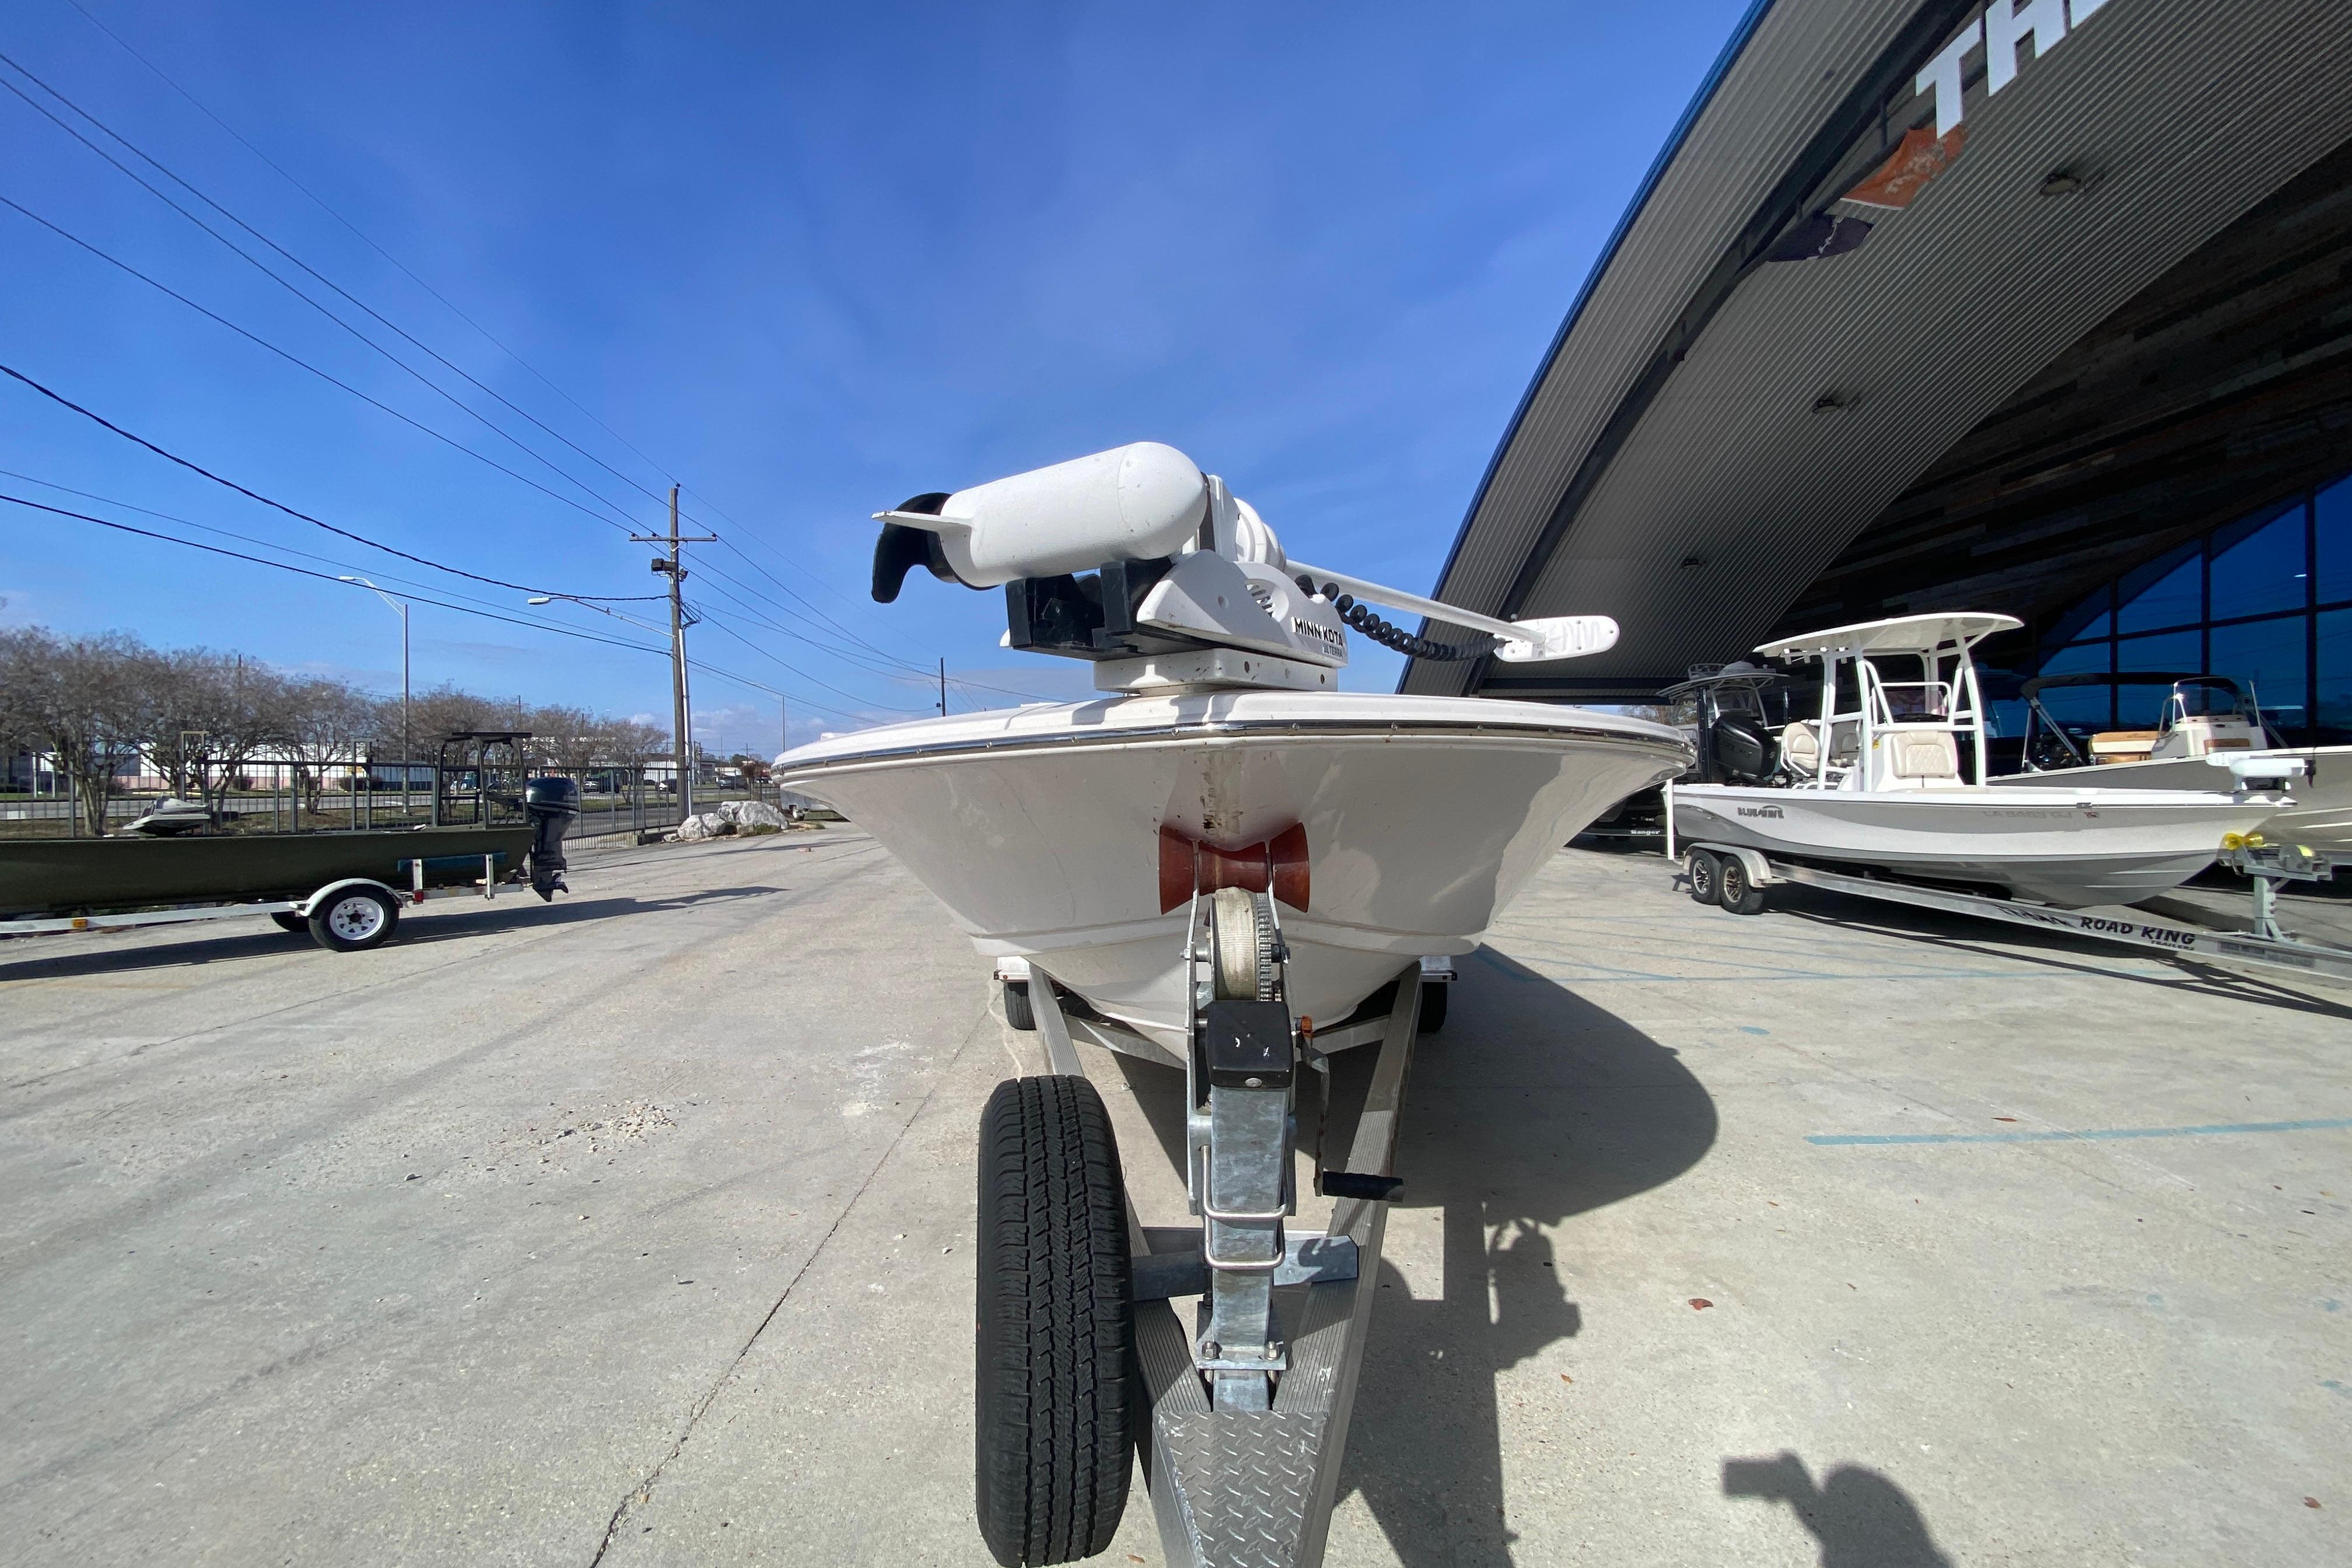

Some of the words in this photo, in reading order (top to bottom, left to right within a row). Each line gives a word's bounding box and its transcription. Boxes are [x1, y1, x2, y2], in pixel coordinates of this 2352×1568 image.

[1916, 0, 2109, 139] TH
[1292, 617, 1321, 639] MINN
[1320, 625, 1343, 646] KOTA
[2080, 916, 2133, 935] ROAD
[2141, 926, 2195, 945] KING
[2151, 940, 2195, 951] TRAILERS
